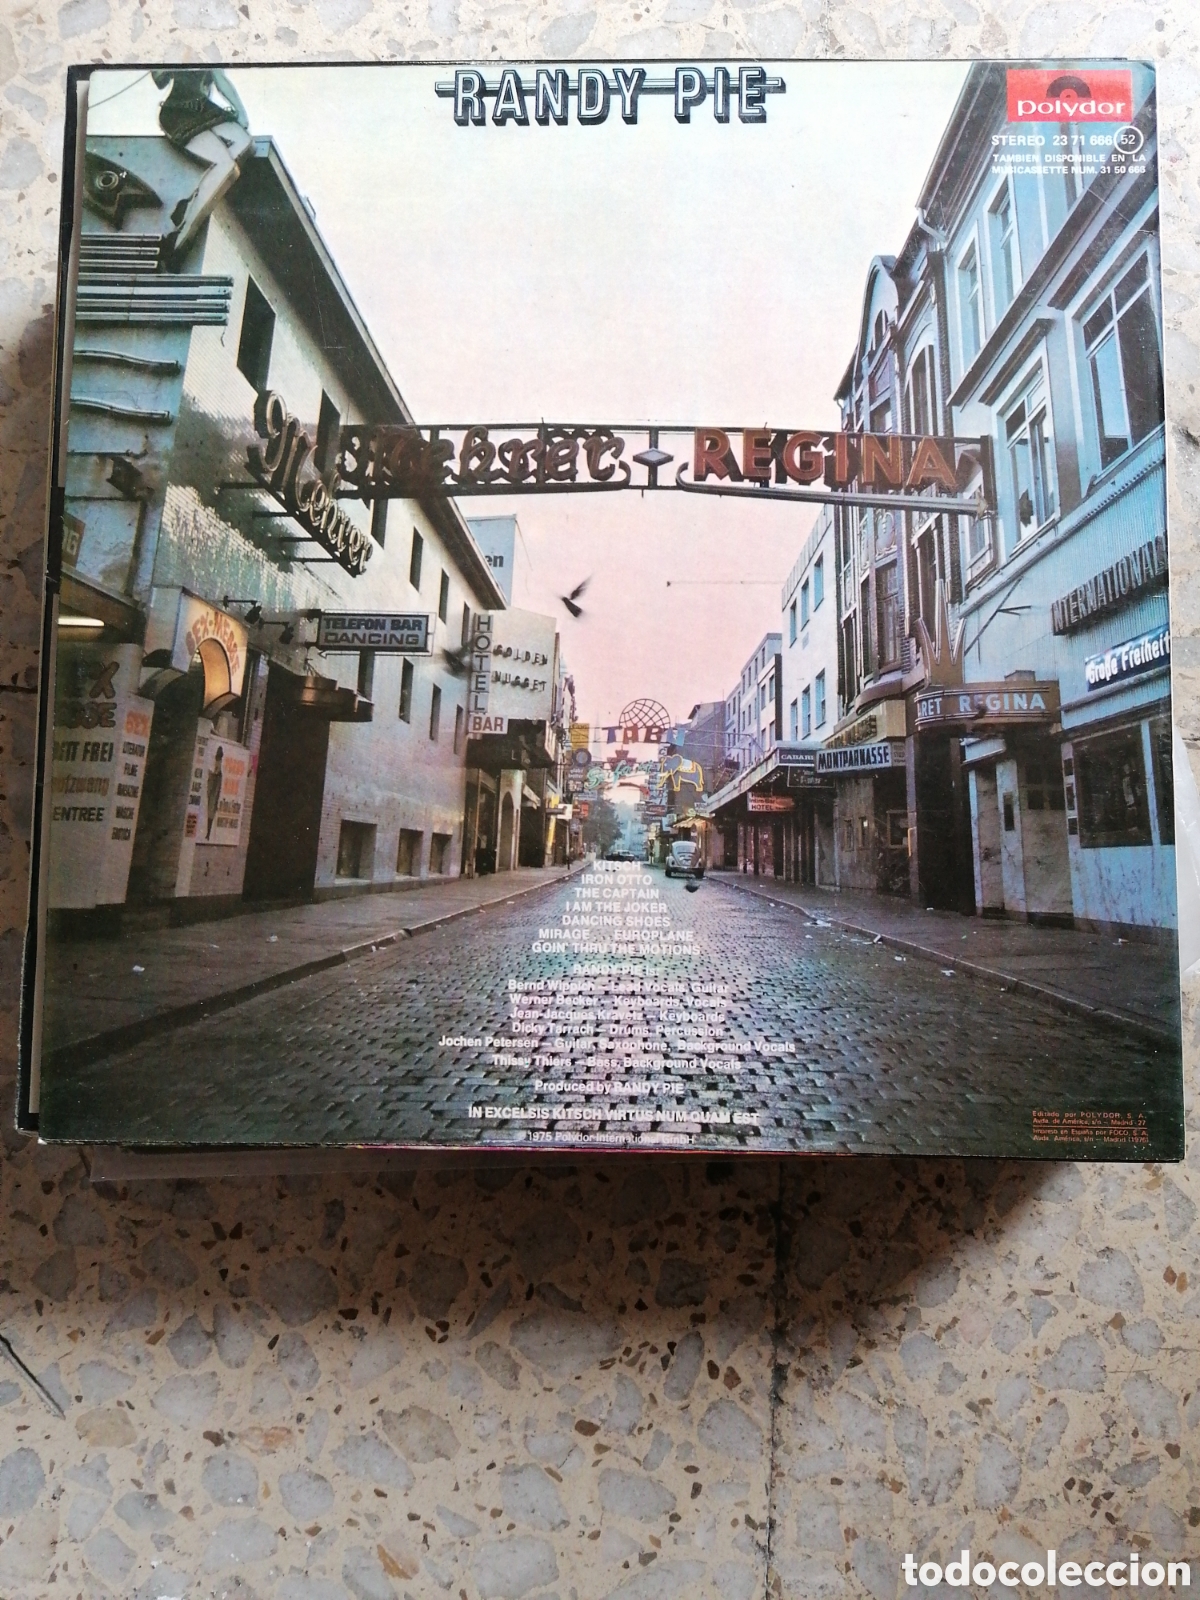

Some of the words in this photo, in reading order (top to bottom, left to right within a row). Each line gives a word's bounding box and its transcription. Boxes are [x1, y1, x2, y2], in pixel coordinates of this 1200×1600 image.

[453, 69, 646, 126] RANDY
[675, 66, 767, 124] PIE
[1017, 100, 1126, 117] polydor
[991, 135, 1046, 146] STEREO
[1052, 135, 1068, 146] 23
[1071, 135, 1086, 146] 71
[1089, 135, 1113, 146] 666
[1120, 134, 1136, 145] 52
[992, 154, 1040, 163] TAMBIEN
[1044, 154, 1106, 163] DISPONIBLE
[1111, 154, 1125, 162] EN
[1132, 154, 1147, 162] LA
[1071, 165, 1098, 174] NUM.
[1100, 165, 1111, 174] 31
[1114, 165, 1126, 174] 50
[693, 427, 958, 490] REGINA
[323, 618, 387, 631] TELEFON
[391, 618, 423, 631] BAR
[324, 633, 420, 645] DANCING
[493, 644, 548, 666] GOLDEN
[1087, 652, 1119, 684] Große
[1121, 630, 1171, 672] Freiheit
[474, 614, 491, 711] HOTEL
[491, 670, 547, 692] NUGGET
[472, 716, 504, 732] BAR
[601, 723, 687, 747] TABU
[818, 745, 890, 770] MONTPARNASSE
[53, 806, 105, 822] ENTREE
[593, 861, 641, 871] KITSCH
[581, 874, 614, 885] IRON
[617, 874, 652, 885] OTTO
[575, 887, 600, 898] THE
[602, 888, 659, 899] CAPTAIN
[573, 902, 592, 912] AM
[595, 902, 621, 912] THE
[624, 903, 667, 913] JOKER
[562, 915, 623, 926] DANCING
[626, 916, 671, 927] SHOES
[539, 928, 590, 939] MIRAGE
[614, 930, 694, 941] EUROPLANE
[572, 942, 607, 954] THRU
[609, 943, 637, 954] THE
[639, 944, 701, 955] MOTIONS
[573, 964, 620, 975] RANDY
[622, 966, 641, 976] PIE
[508, 979, 545, 990] Bernd
[547, 980, 595, 992] Wippich
[611, 982, 641, 992] Lead
[691, 982, 729, 993] Guitar
[509, 993, 554, 1005] Werner
[556, 994, 598, 1005] Becker
[686, 996, 727, 1008] Vocals
[510, 1007, 594, 1021] Jean-Jacques
[597, 1009, 644, 1020] Kravetz
[660, 1010, 725, 1022] Keyboards
[512, 1022, 546, 1035] Dicky
[547, 1023, 594, 1034] Tarrach
[655, 1025, 723, 1036] Percussion
[438, 1035, 482, 1047] Jochen
[485, 1036, 539, 1048] Petersen
[599, 1038, 671, 1052] Saxophone,
[677, 1040, 750, 1053] Background
[753, 1041, 796, 1052] Vocals
[492, 1054, 531, 1068] Thissy
[534, 1055, 572, 1067] Thiers
[623, 1058, 697, 1071] Background
[700, 1060, 742, 1070] Vocals
[534, 1080, 594, 1092] Produced
[596, 1080, 612, 1094] by
[613, 1082, 661, 1093] RANDY
[662, 1083, 684, 1094] PIE
[468, 1106, 482, 1118] IN
[485, 1107, 550, 1119] EXCELSIS
[552, 1108, 601, 1120] KITSCH
[605, 1110, 653, 1121] VIRTUS
[732, 1112, 760, 1124] EST
[528, 1131, 552, 1141] 1975
[555, 1132, 593, 1142] Polydor
[596, 1132, 658, 1144] International
[661, 1135, 695, 1144] GmbH
